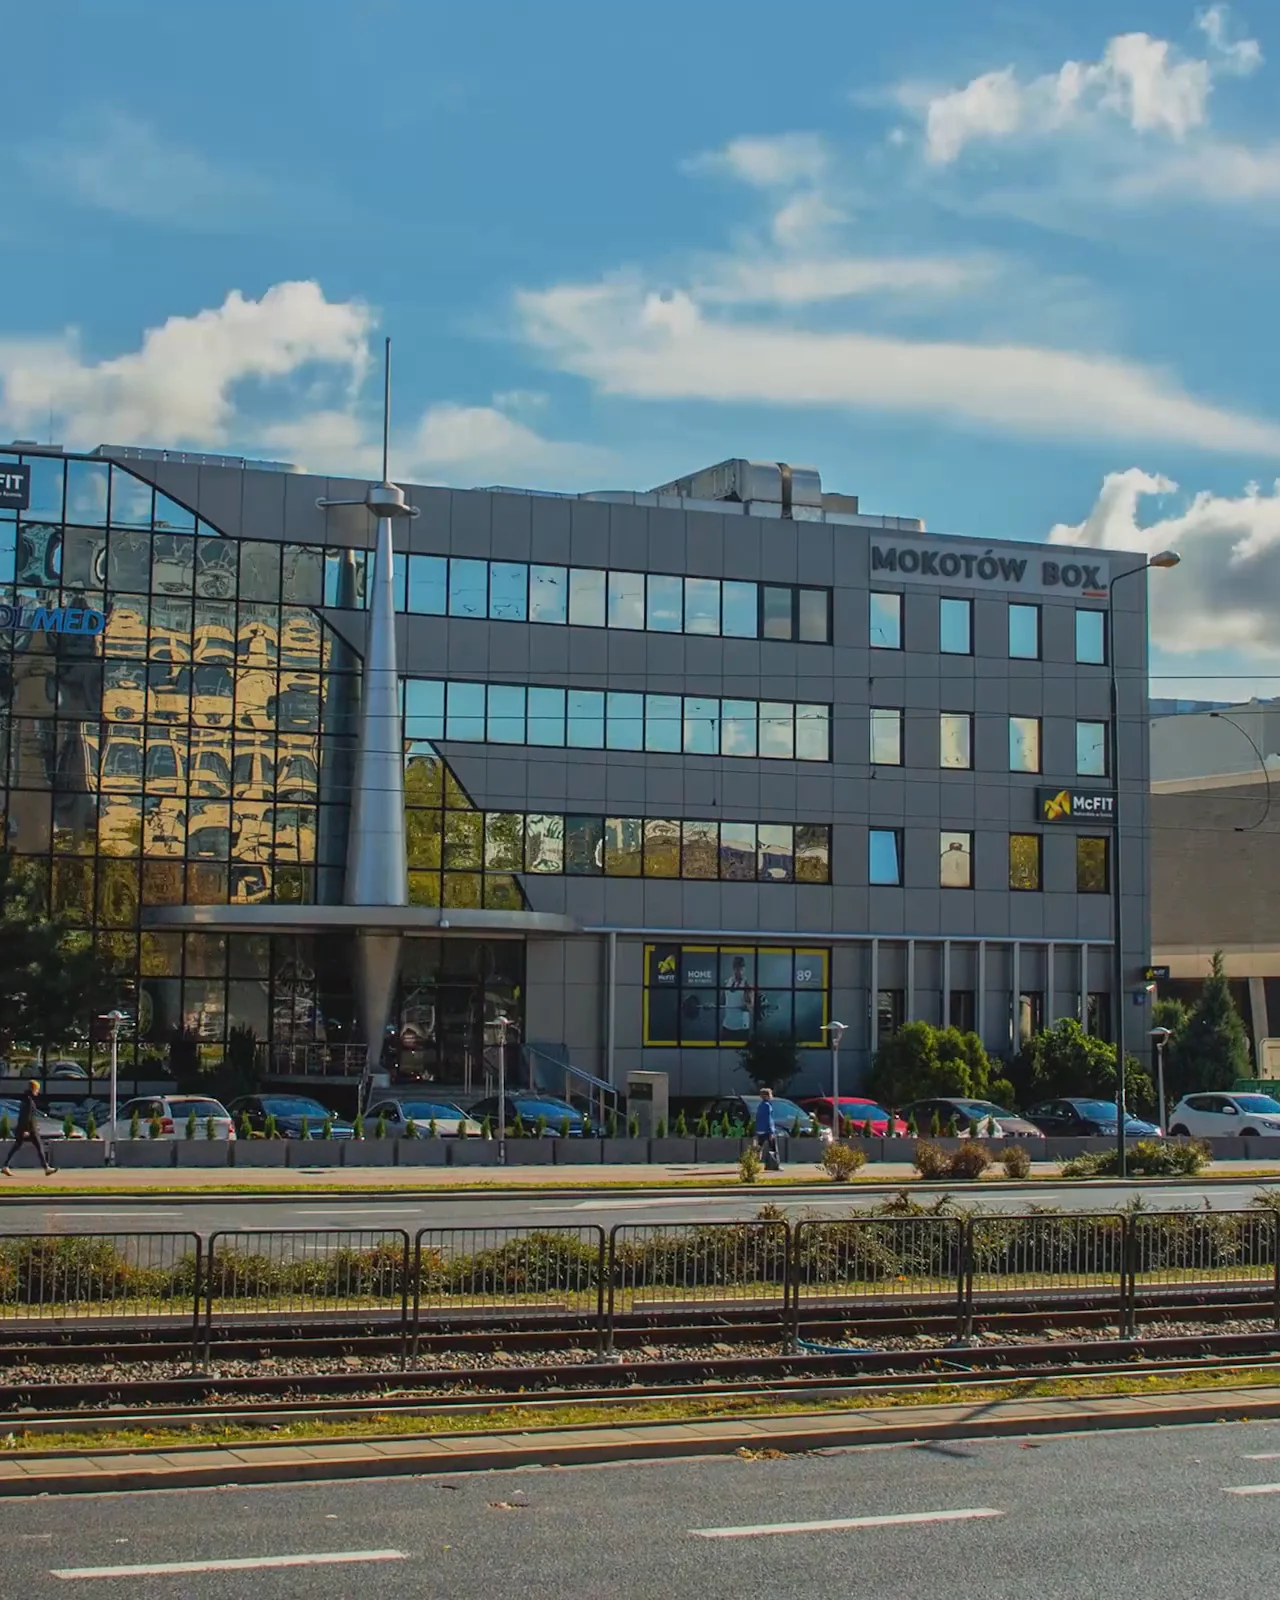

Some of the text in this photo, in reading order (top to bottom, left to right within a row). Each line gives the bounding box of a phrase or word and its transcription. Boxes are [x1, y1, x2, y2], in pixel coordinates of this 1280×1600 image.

[871, 546, 1028, 583] MOKOTÓW
[1073, 796, 1114, 811] McFIT
[687, 970, 713, 979] HOME
[796, 969, 813, 982] 89
